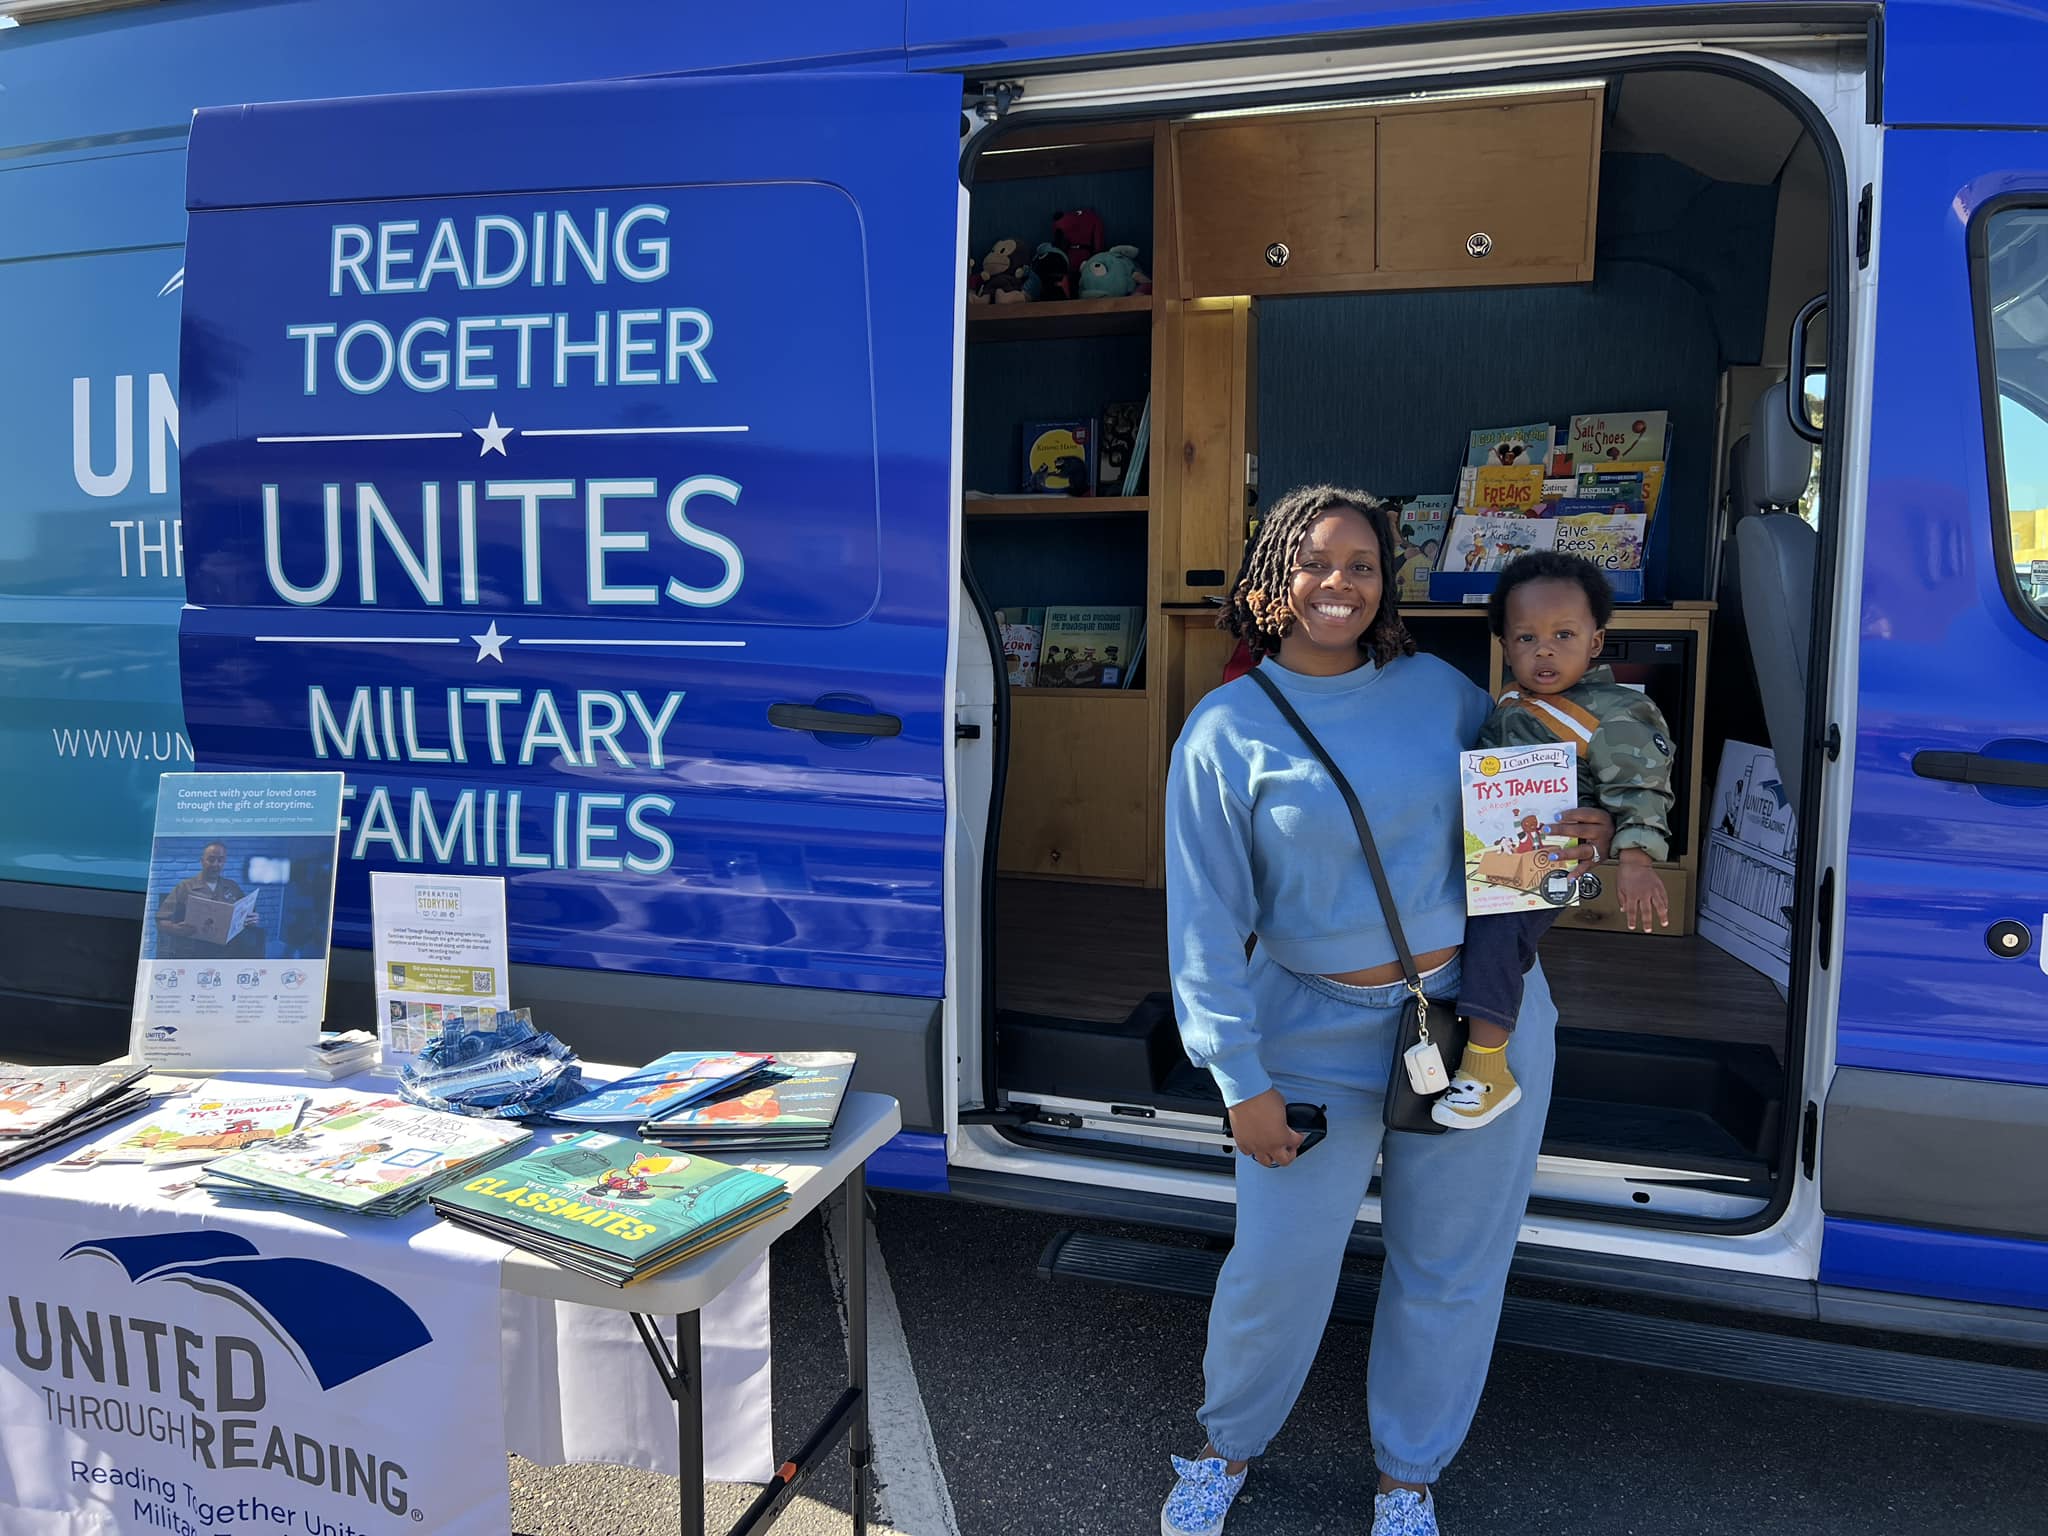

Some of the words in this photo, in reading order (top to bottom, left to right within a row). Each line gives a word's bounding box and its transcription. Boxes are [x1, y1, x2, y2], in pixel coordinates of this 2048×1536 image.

[329, 204, 671, 296] READING
[286, 307, 717, 395] TOGETHER
[1574, 416, 1594, 440] Salt
[1594, 431, 1625, 455] Shoes
[1483, 483, 1532, 503] FREAKS
[261, 475, 745, 608] UNITES
[308, 685, 686, 771] MILITARY
[1504, 760, 1508, 768] I
[1510, 758, 1529, 768] Can
[1532, 752, 1560, 763] Read!
[178, 788, 217, 798] Connect
[220, 788, 240, 798] with
[242, 790, 264, 800] your
[266, 788, 292, 798] loved
[294, 789, 317, 797] ones
[1473, 781, 1503, 800] TY'S
[1505, 777, 1569, 797] TRAVELS
[177, 801, 215, 812] through
[217, 801, 233, 809] the
[234, 801, 250, 811] gift
[253, 800, 264, 809] of
[265, 800, 314, 811] storytime.
[1746, 794, 1773, 817] UNITED
[418, 898, 459, 910] STORYTIME
[224, 1104, 292, 1115] TRAVELS
[464, 1177, 656, 1241] CLASSMATES
[8, 1295, 267, 1413] UNITED
[41, 1386, 187, 1449] THROUGH
[192, 1413, 409, 1517] READING
[71, 1461, 176, 1504] Reading
